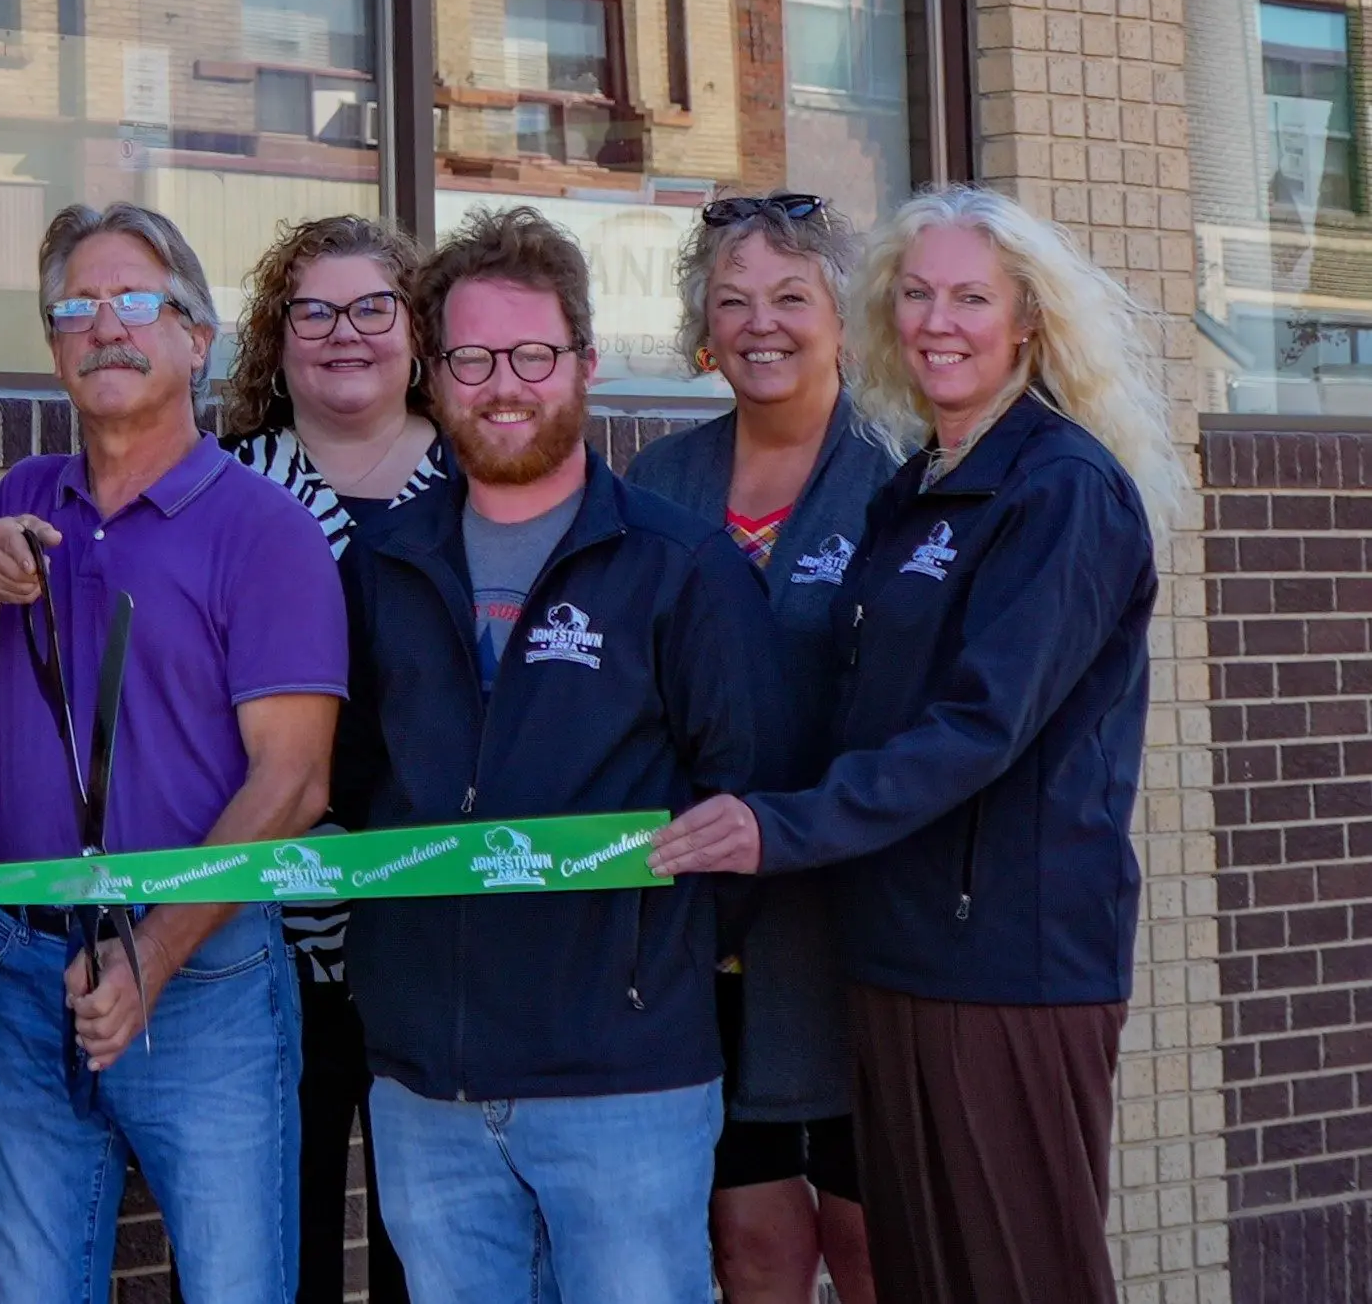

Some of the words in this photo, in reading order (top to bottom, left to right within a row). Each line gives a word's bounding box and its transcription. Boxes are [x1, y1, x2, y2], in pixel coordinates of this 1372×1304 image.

[527, 627, 603, 649] JAMESTOWN
[352, 835, 459, 888] Congratulations
[470, 853, 554, 872] JAMESTOWN
[559, 827, 659, 878] Congratulatio
[142, 852, 249, 894] Congratulations
[260, 865, 343, 883] JAMESTOWN
